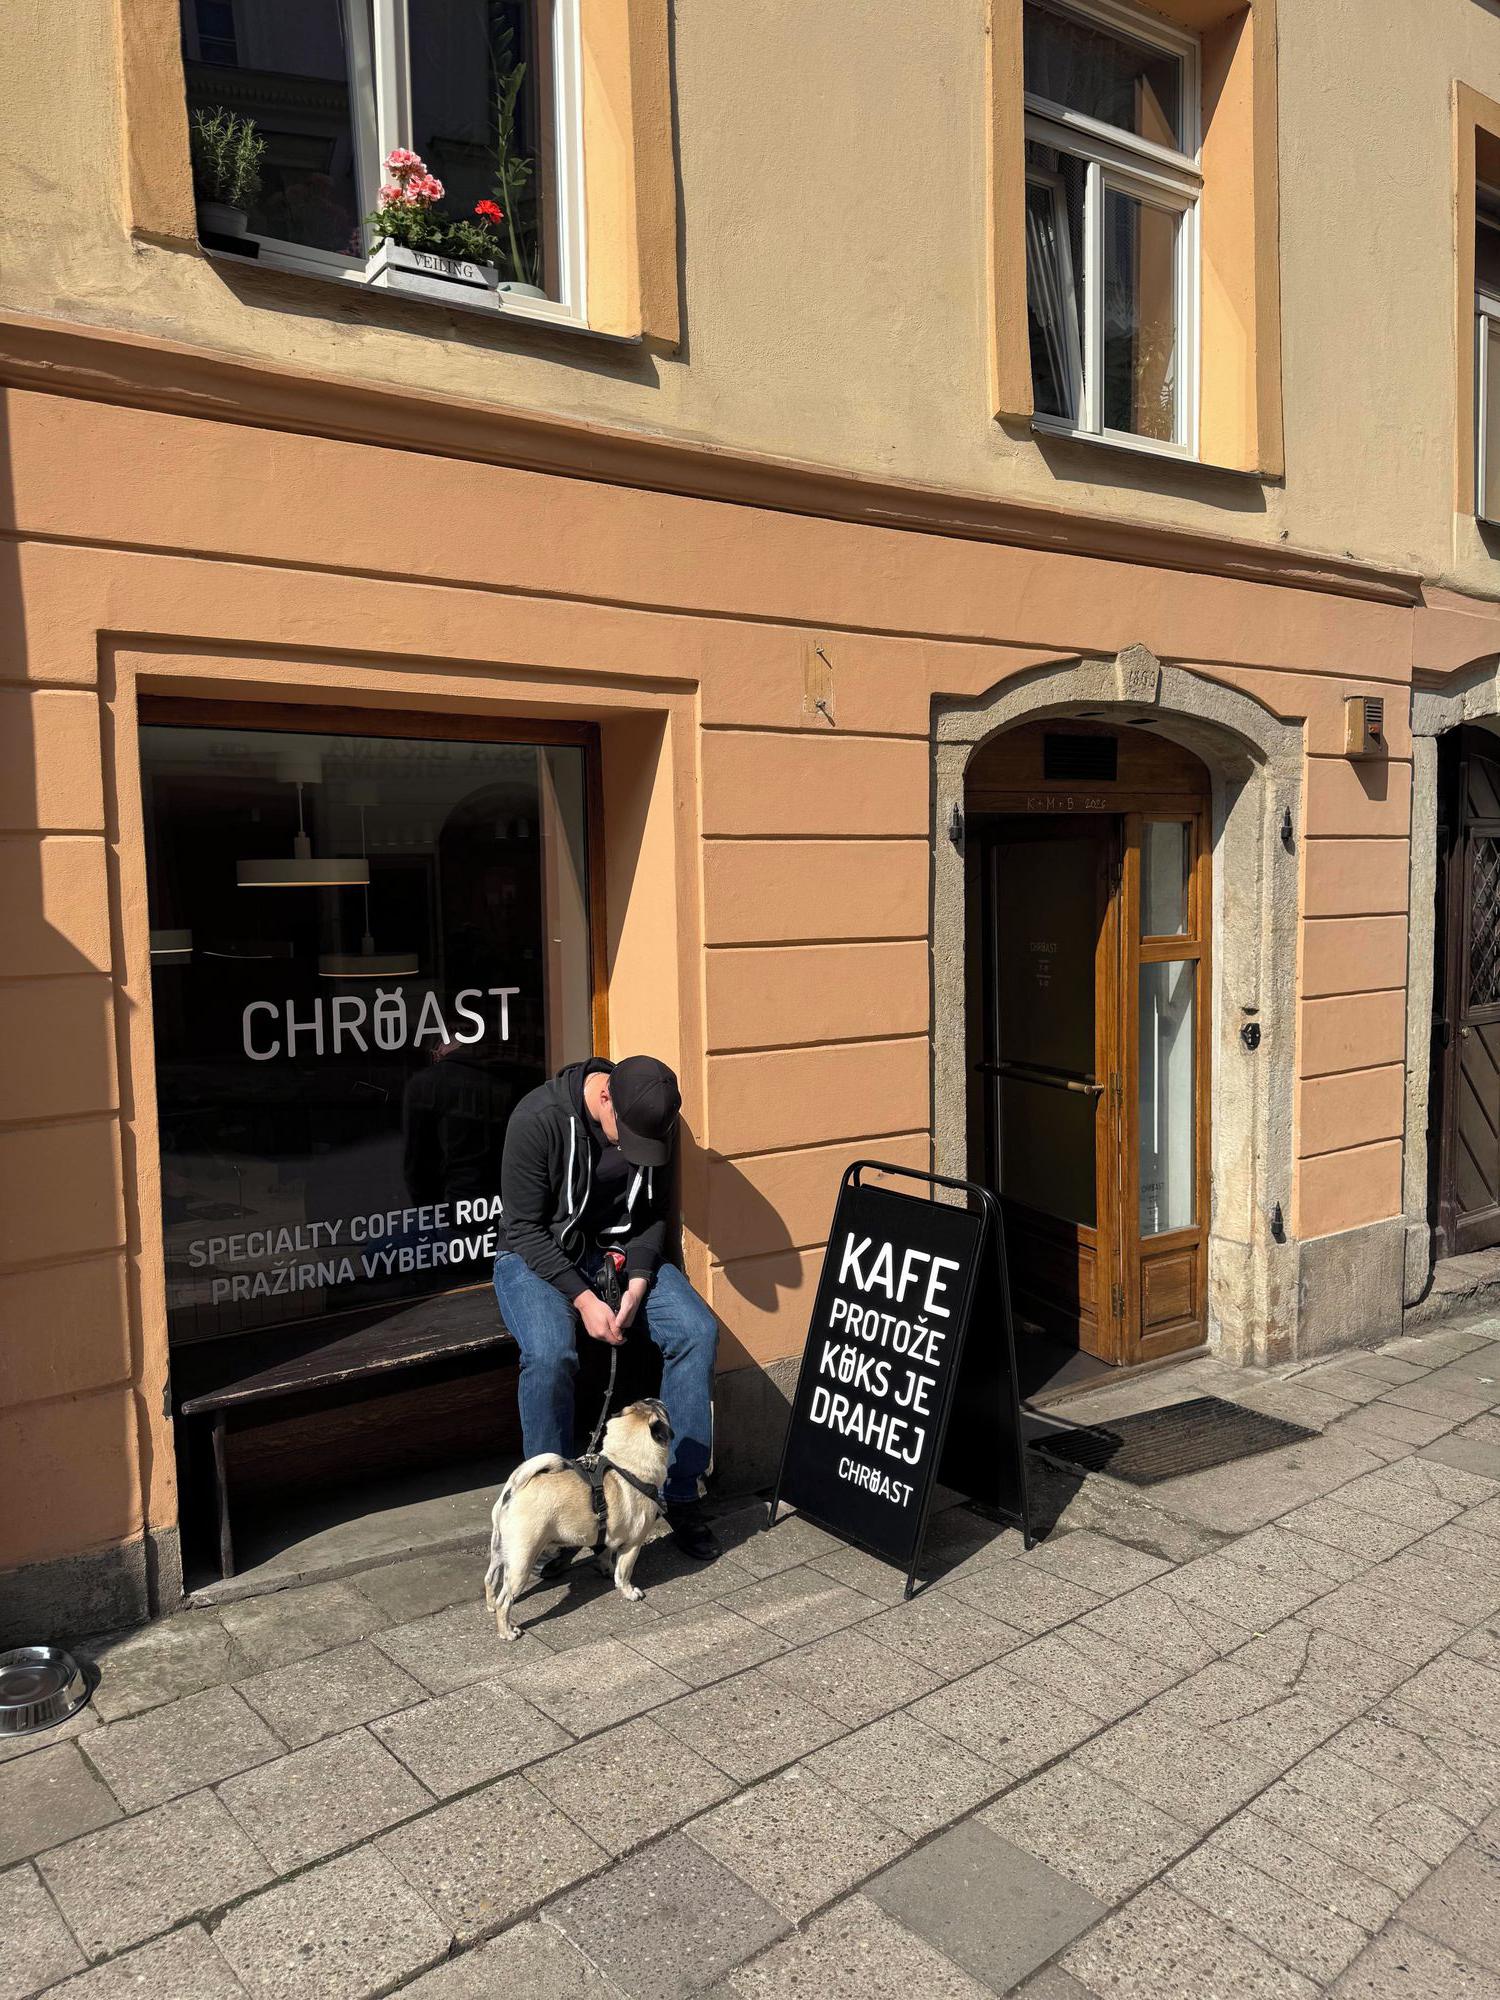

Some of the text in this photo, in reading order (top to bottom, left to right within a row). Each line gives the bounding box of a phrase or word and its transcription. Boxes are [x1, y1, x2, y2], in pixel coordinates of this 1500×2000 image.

[413, 252, 473, 278] VEILING
[242, 986, 521, 1061] CHROAST
[189, 1219, 343, 1268] SPECIALTY
[350, 1202, 450, 1242] COFFEE
[212, 1225, 499, 1305] PRAŽÍRNA VÝBĚROVÉ
[838, 1231, 960, 1318] KAFE
[828, 1297, 946, 1367] PROTOŽE
[809, 1385, 926, 1466] DRAHEJ
[894, 1370, 936, 1417] JE
